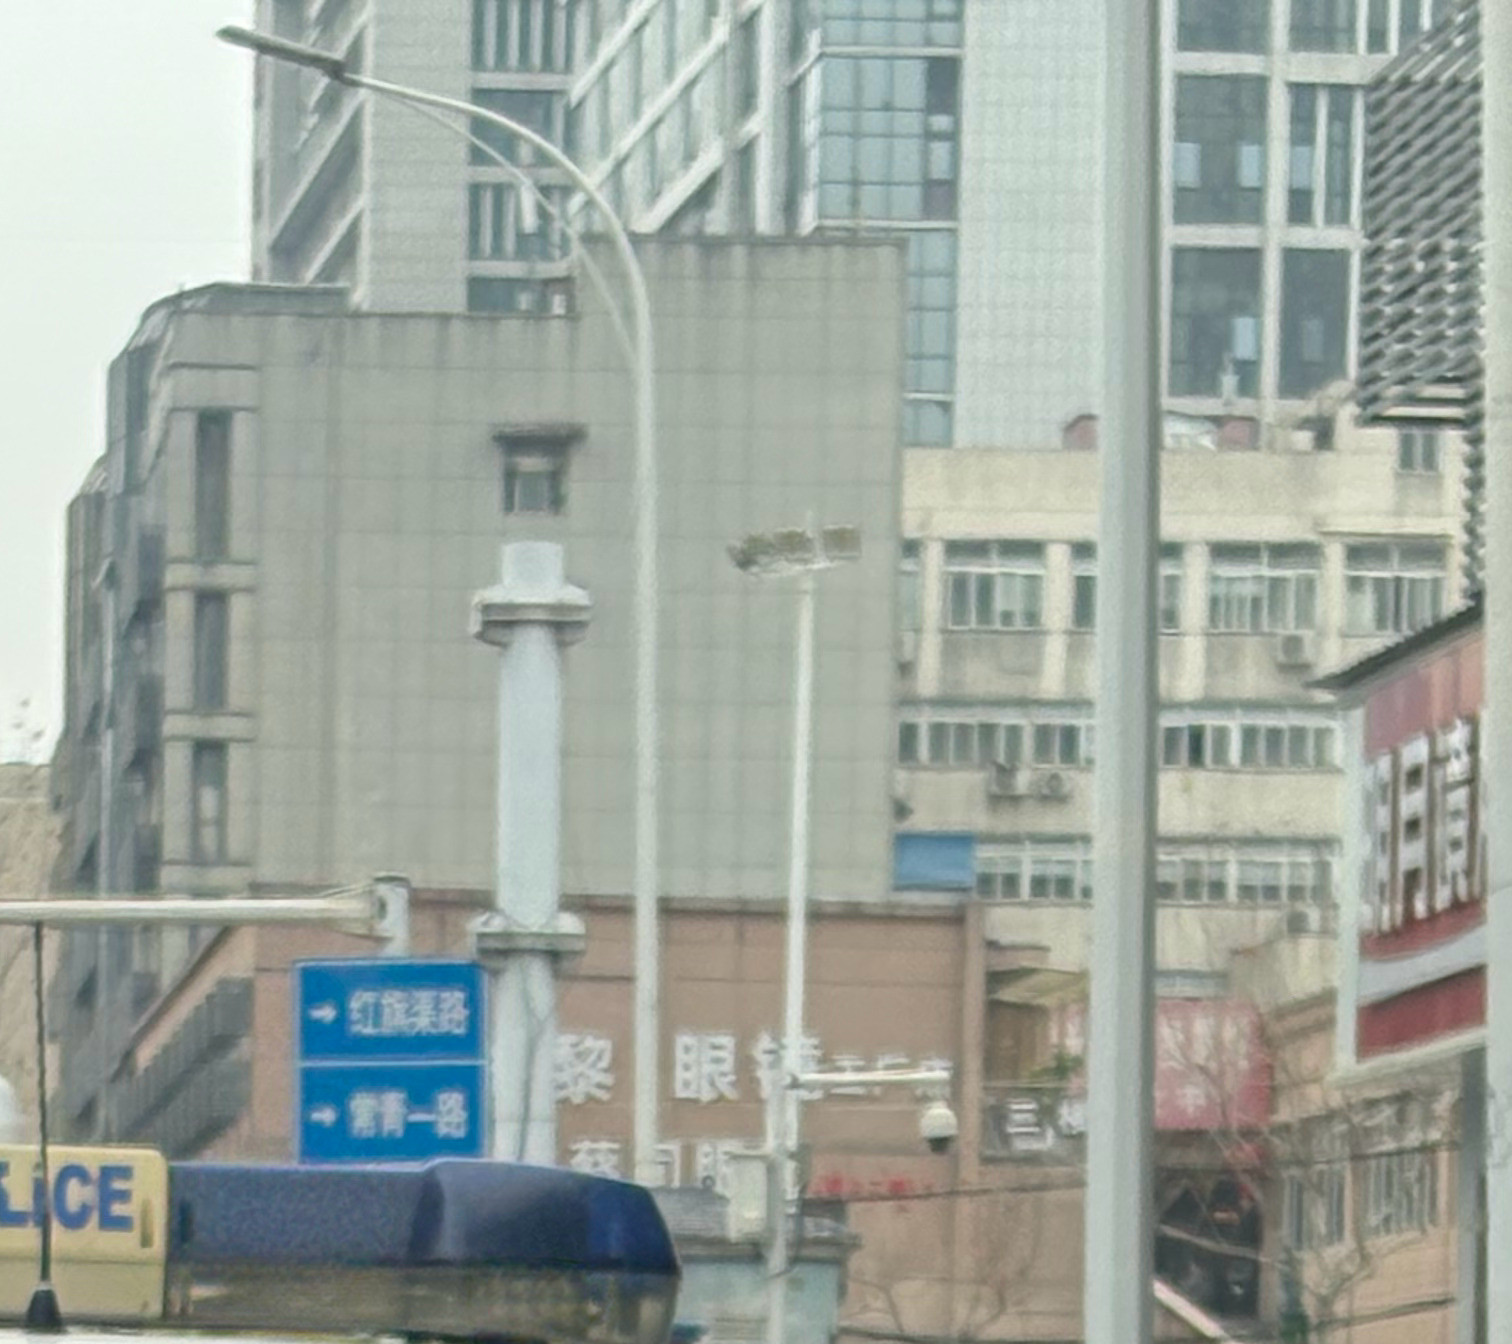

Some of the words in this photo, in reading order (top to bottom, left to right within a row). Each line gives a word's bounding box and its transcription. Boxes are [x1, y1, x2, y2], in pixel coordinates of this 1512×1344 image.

[349, 990, 469, 1035] 红旗渠路
[349, 1091, 468, 1139] 常青一路
